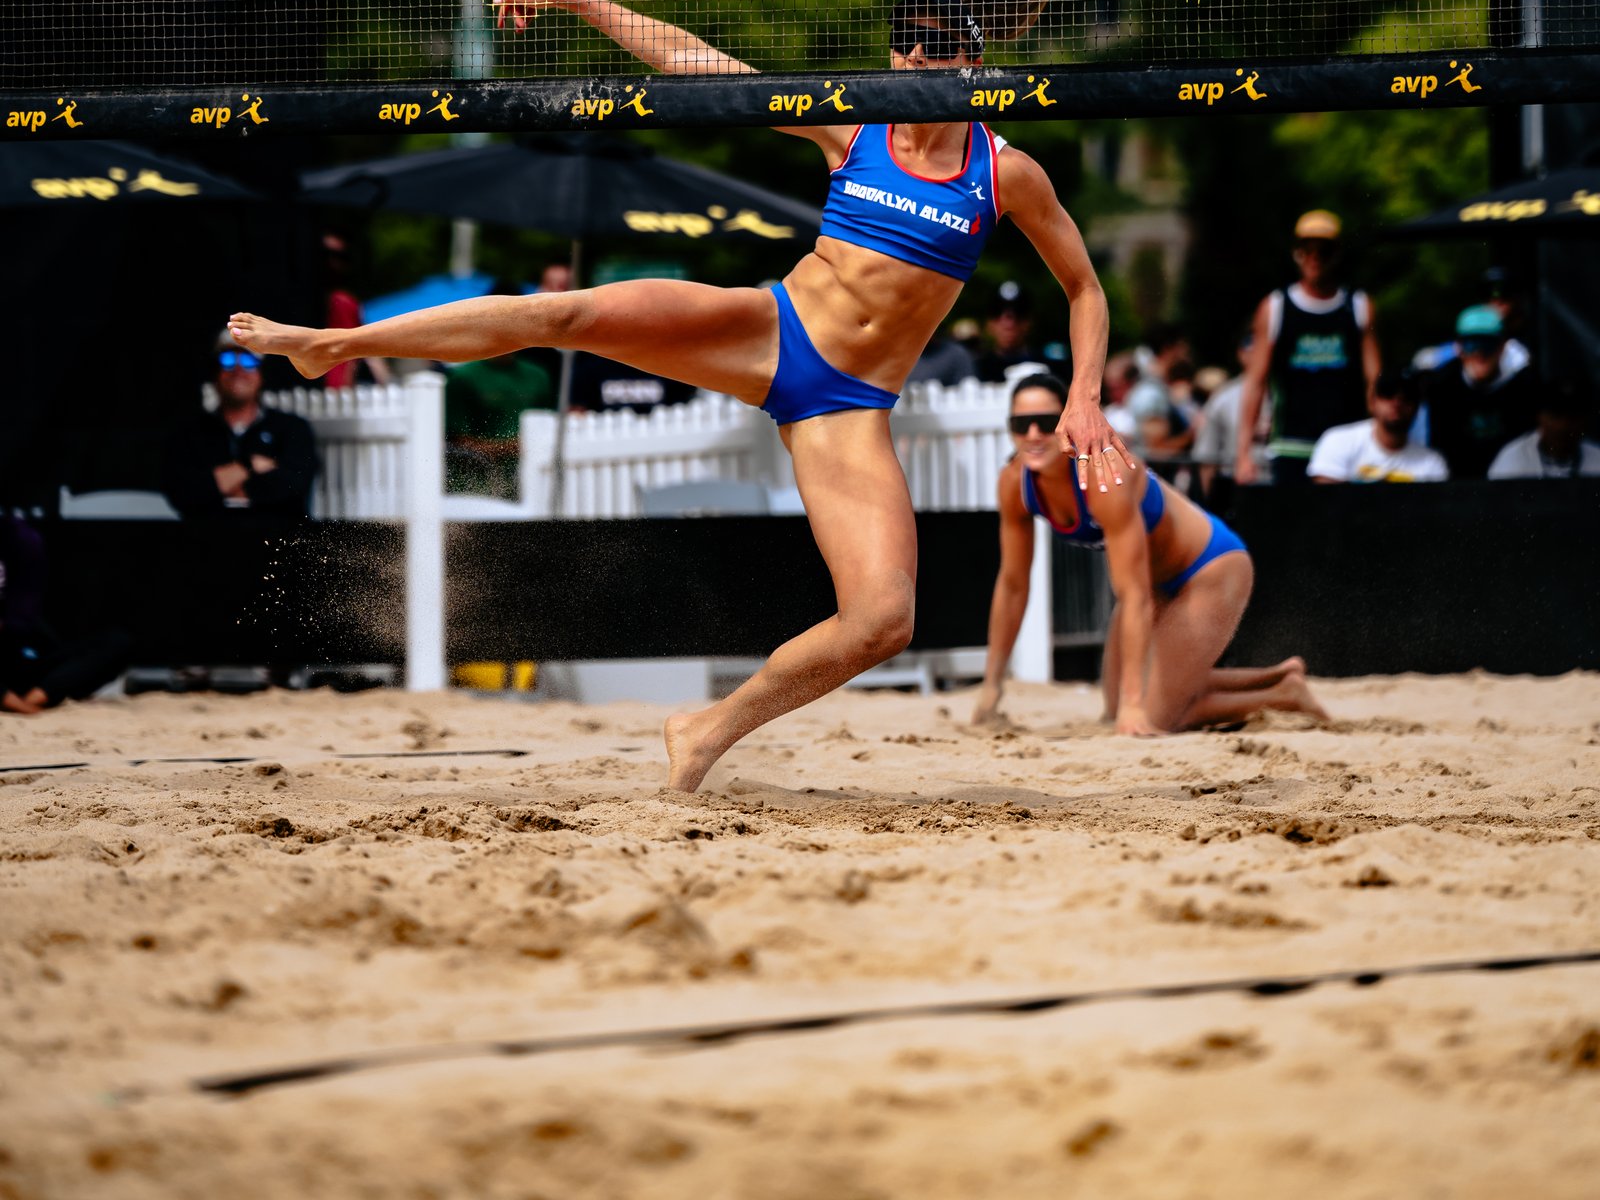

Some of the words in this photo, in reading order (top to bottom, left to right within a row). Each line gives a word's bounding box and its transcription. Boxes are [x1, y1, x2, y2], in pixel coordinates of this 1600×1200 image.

[1178, 82, 1224, 106] avp
[1391, 75, 1437, 99] avp
[572, 97, 614, 121] avp
[769, 93, 812, 117] avp
[971, 88, 1015, 112] avp
[6, 110, 46, 132] avp
[190, 106, 231, 129] avp
[379, 103, 420, 125] avp
[843, 180, 917, 215] BROOKLYN
[918, 205, 971, 235] BLAZE
